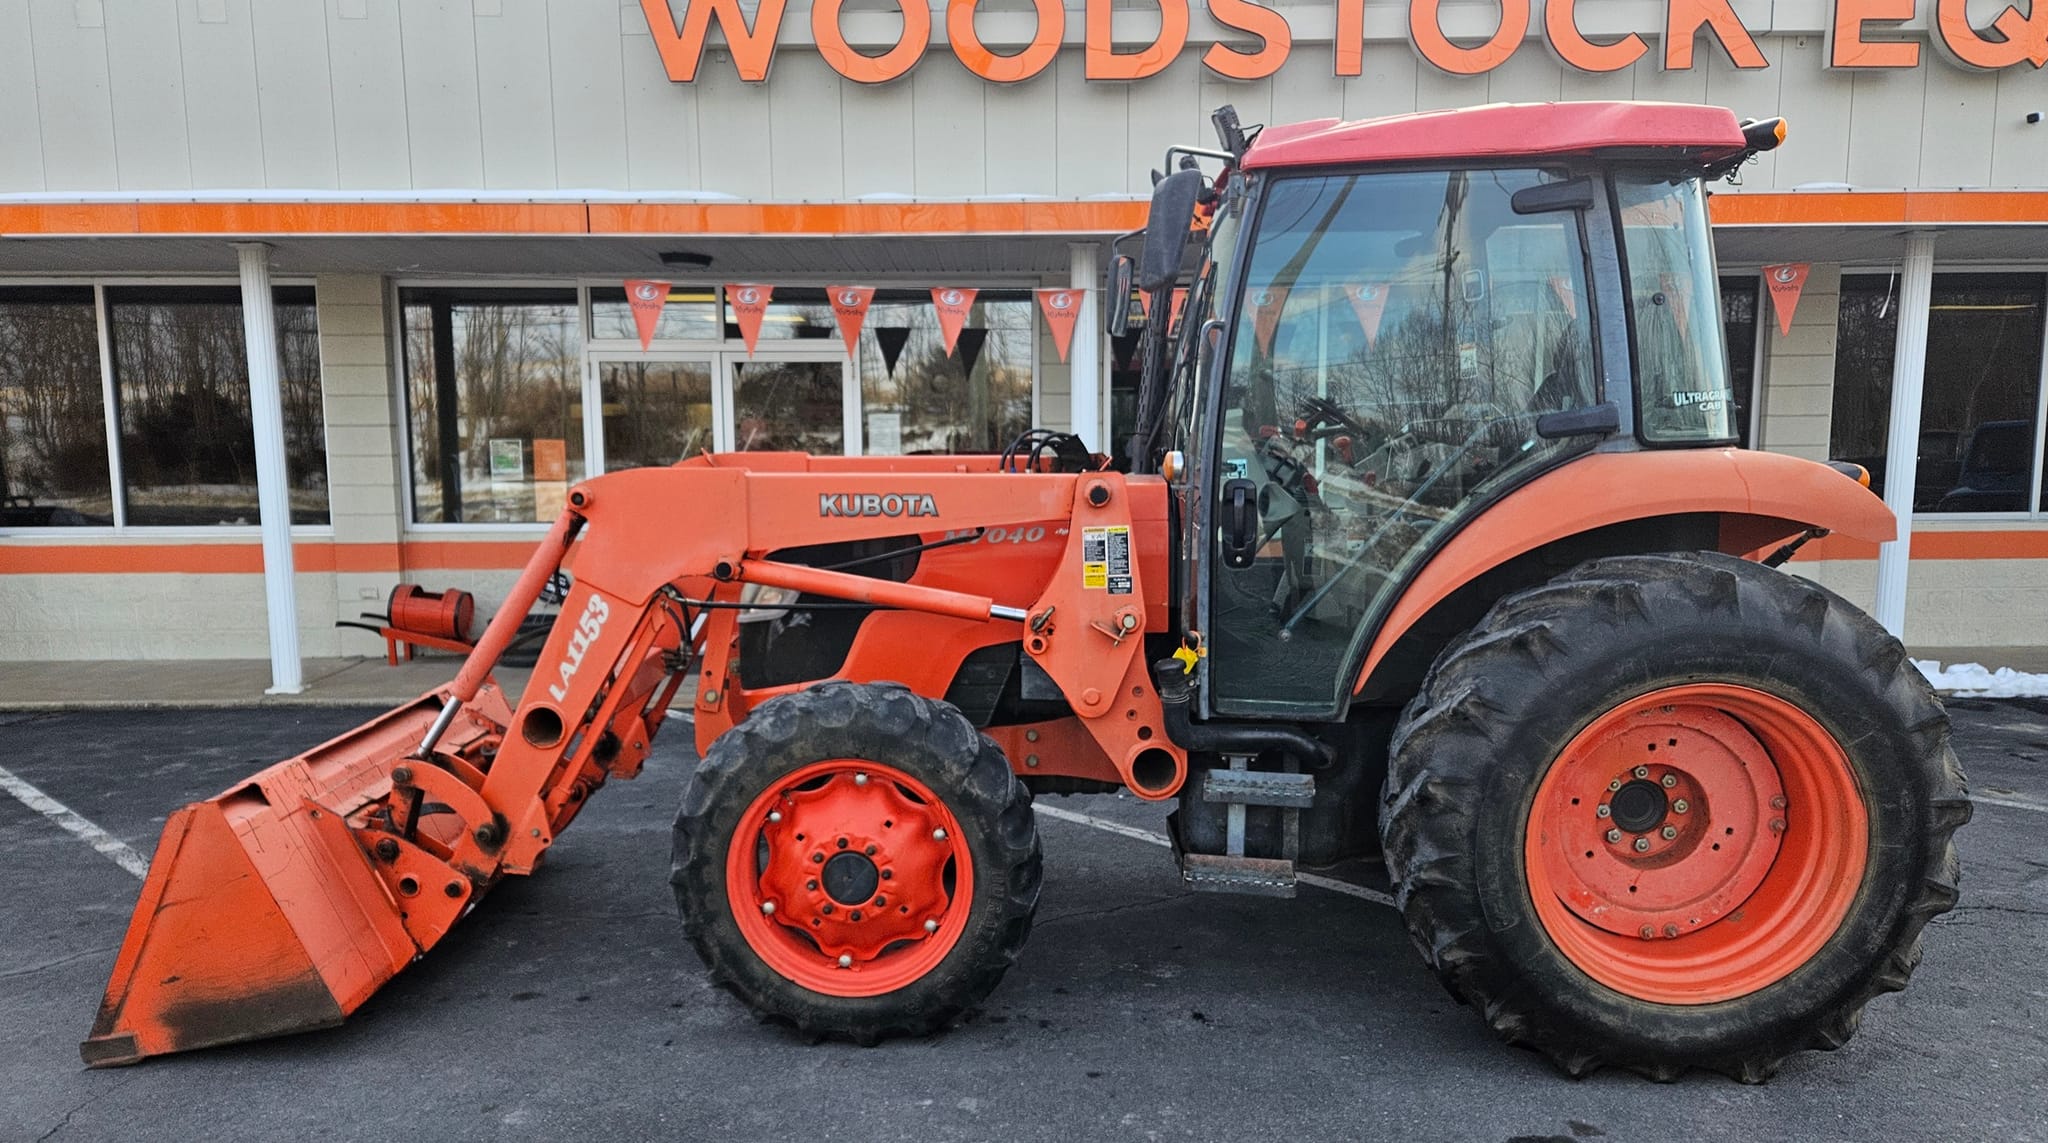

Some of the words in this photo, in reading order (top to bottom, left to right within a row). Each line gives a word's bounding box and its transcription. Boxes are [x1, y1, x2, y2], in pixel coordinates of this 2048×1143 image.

[639, 0, 1768, 83] WOODSTOCK
[819, 493, 940, 518] KUBOTA
[549, 593, 610, 703] LA1153
